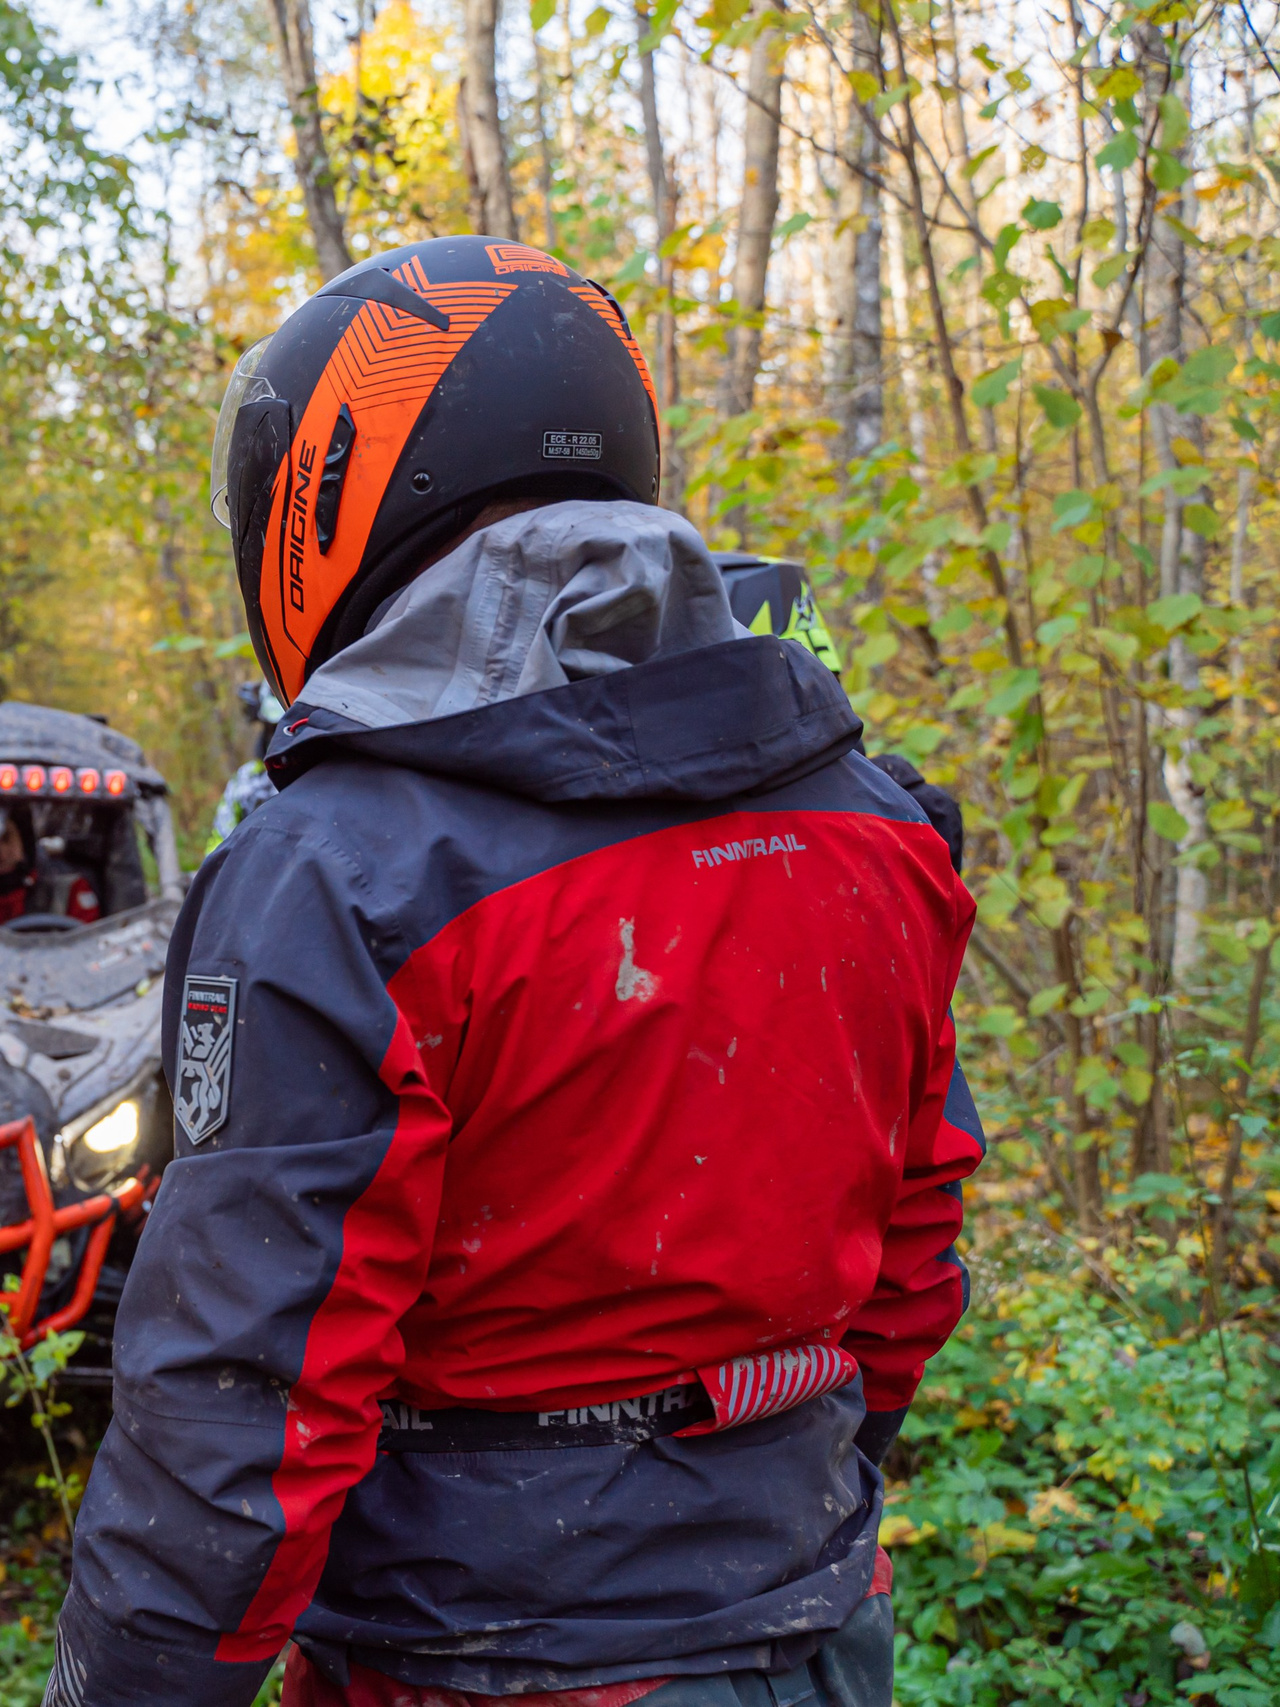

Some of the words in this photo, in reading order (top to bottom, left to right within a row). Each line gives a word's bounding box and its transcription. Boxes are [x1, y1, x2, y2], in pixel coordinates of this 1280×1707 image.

[550, 435, 567, 444] ECE
[572, 435, 578, 444] R
[579, 436, 597, 445] 22.05
[290, 439, 317, 613] ORIGINE
[691, 833, 807, 869] FINNTRAIL
[188, 990, 228, 1005] FINNTRAIL
